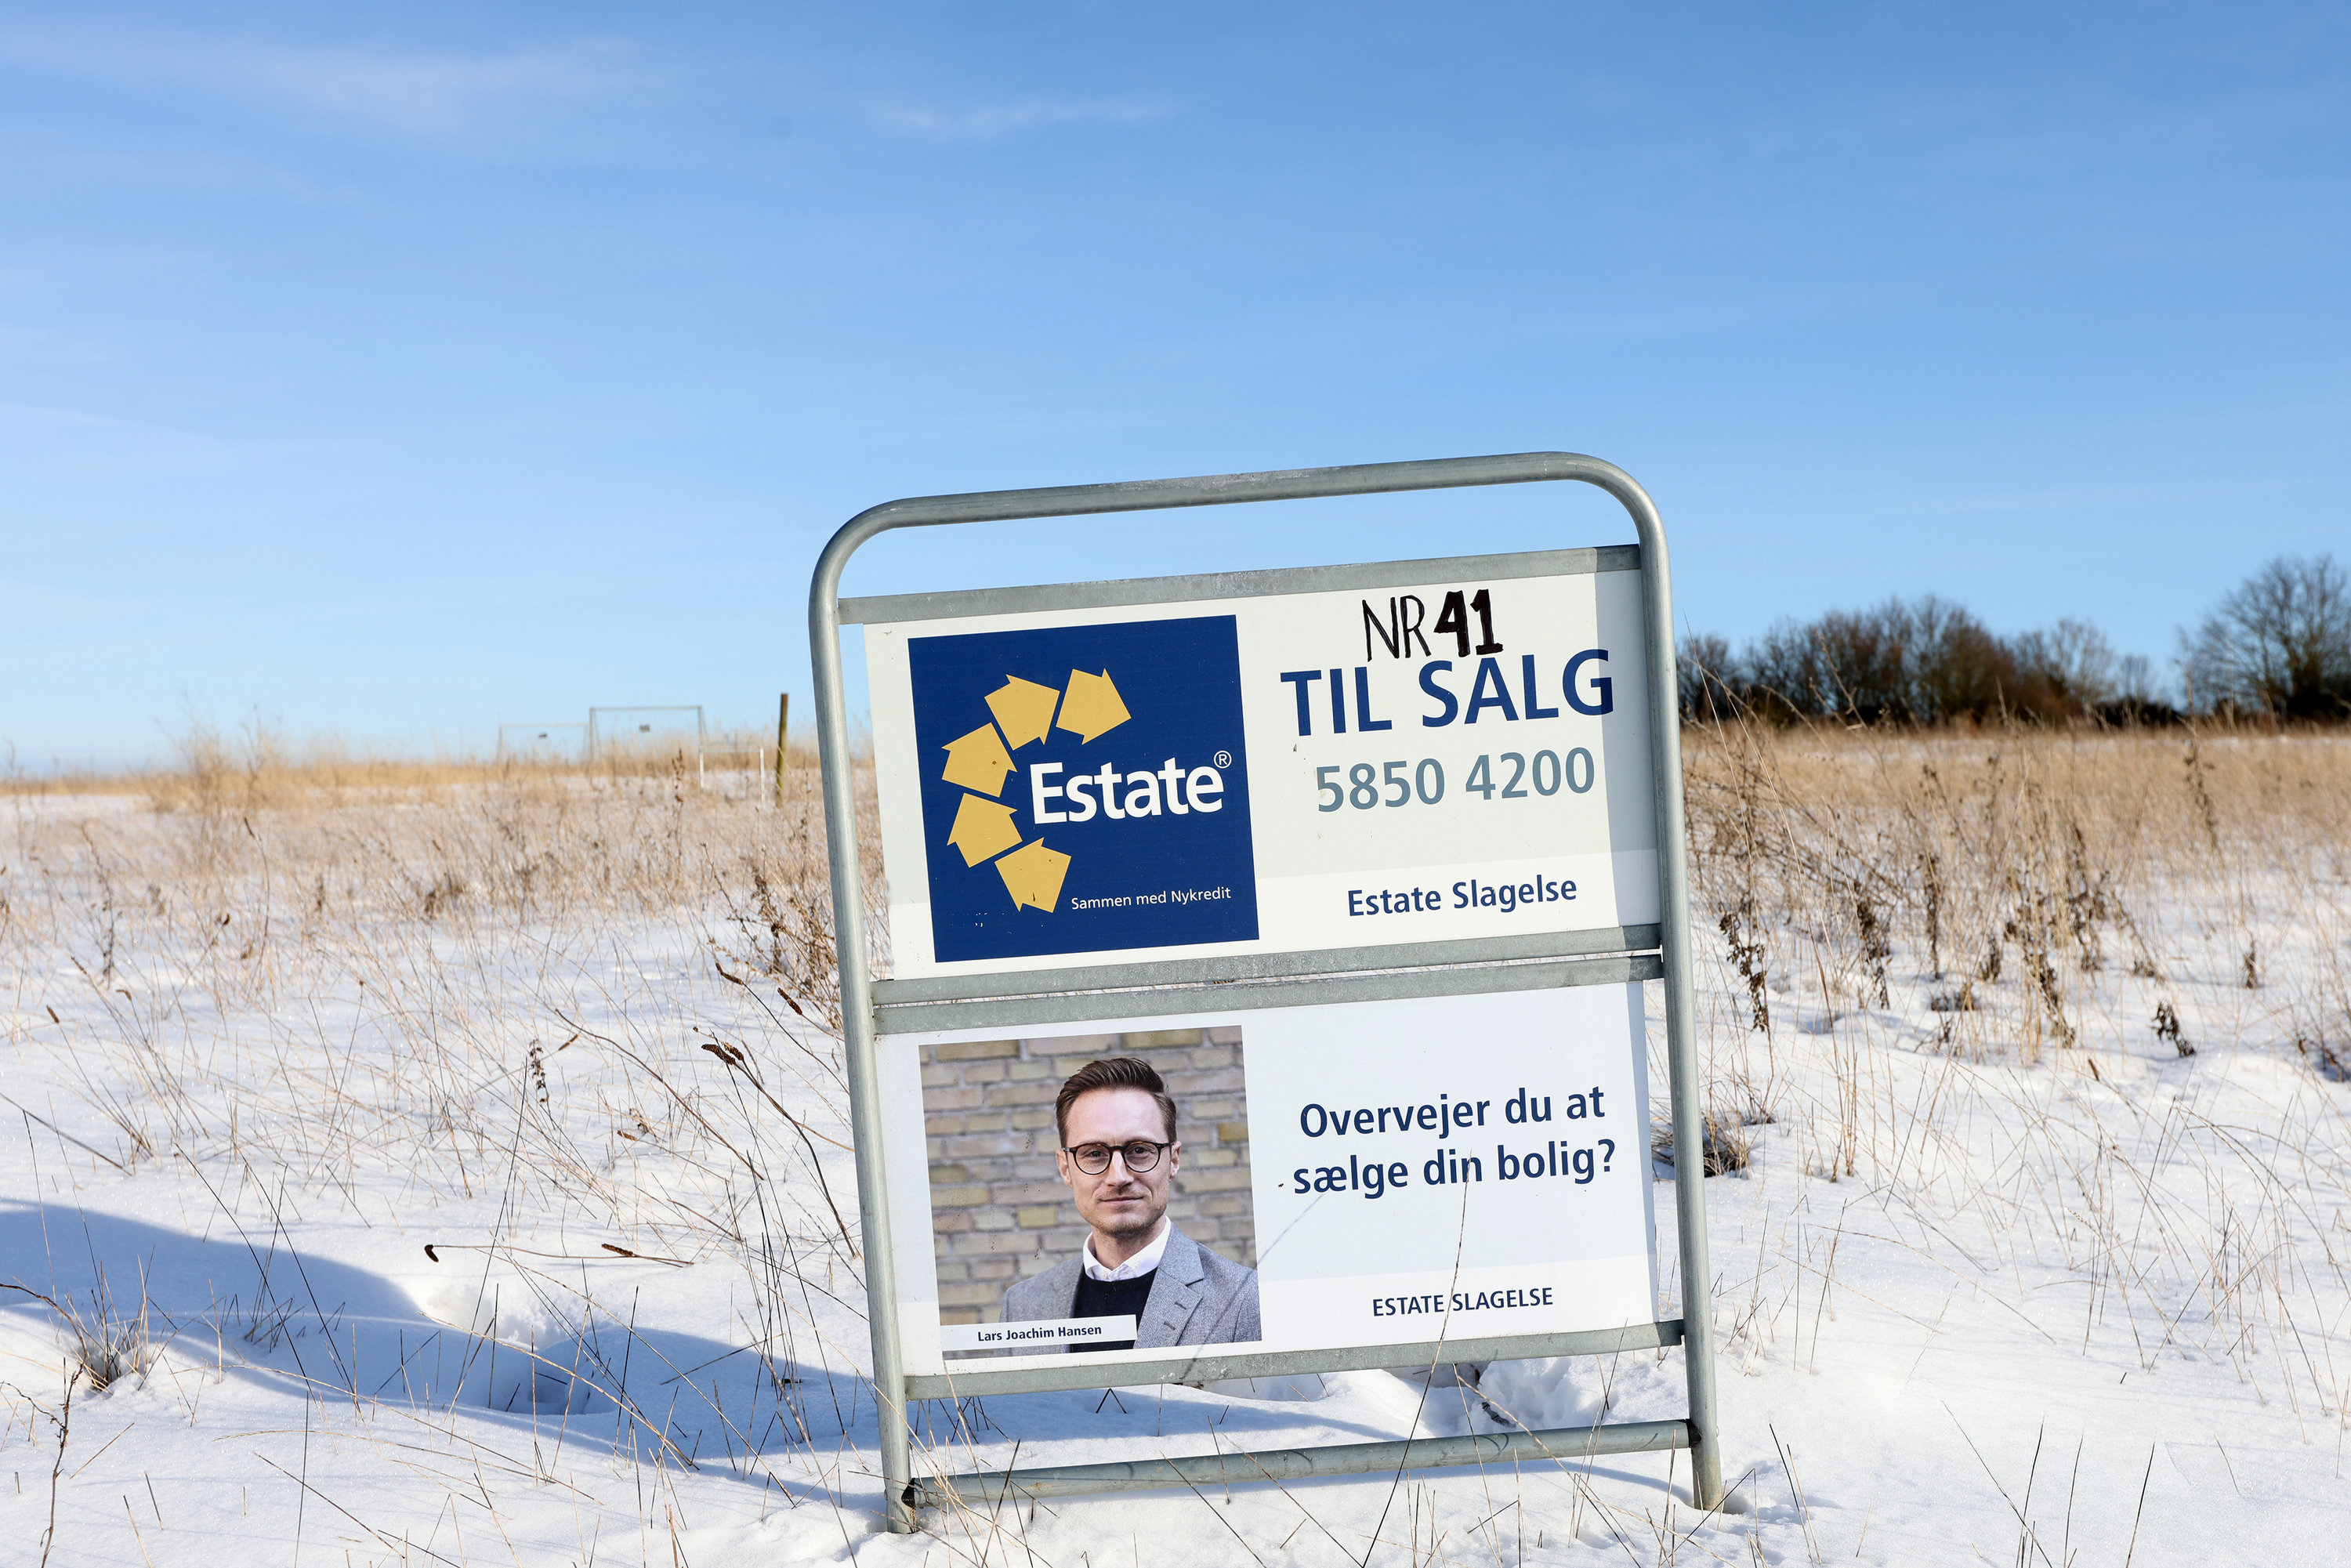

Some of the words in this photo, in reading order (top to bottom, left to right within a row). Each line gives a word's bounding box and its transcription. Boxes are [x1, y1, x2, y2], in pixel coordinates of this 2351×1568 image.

[1434, 589, 1504, 657] 41
[1280, 667, 1393, 736] TIL
[1418, 649, 1614, 728] SALG
[1317, 758, 1445, 813] 5850
[1465, 747, 1595, 801] 4200
[1071, 896, 1132, 910] Sammen
[1136, 891, 1167, 905] med
[1171, 886, 1232, 904] Nykredit
[1348, 886, 1441, 917] Estate
[1453, 875, 1578, 913] Slagelse
[1300, 1094, 1490, 1139] Overvejer
[1505, 1087, 1552, 1124] du
[1566, 1086, 1606, 1121] at
[1294, 1154, 1408, 1199] sælge
[1423, 1148, 1483, 1186] din
[1497, 1139, 1616, 1185] bolig?
[1373, 1295, 1444, 1316] ESTATE
[1452, 1287, 1553, 1312] SLAGELSE
[977, 1331, 1002, 1342] Lars
[1005, 1328, 1054, 1340] Joachim
[1058, 1326, 1102, 1337] Hansen
